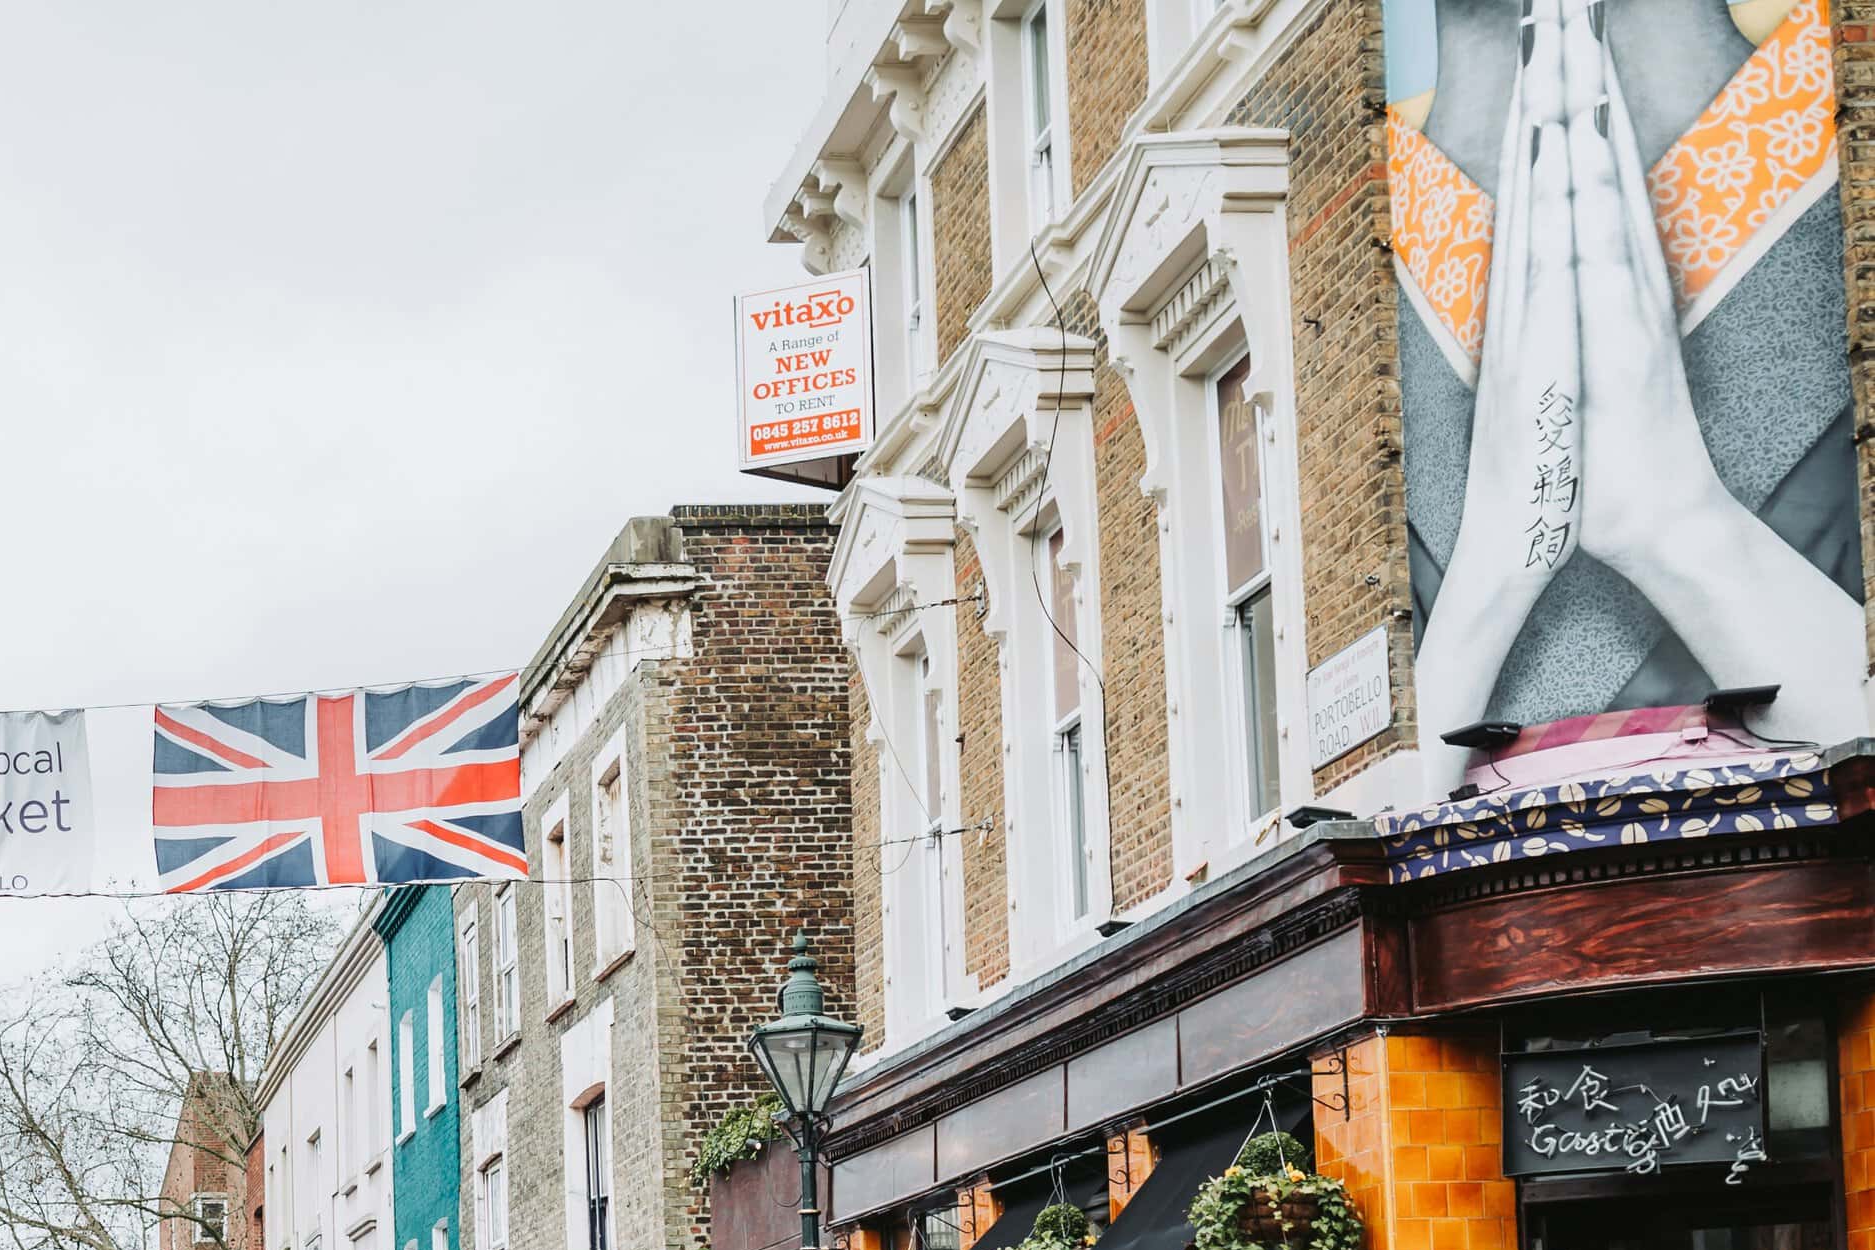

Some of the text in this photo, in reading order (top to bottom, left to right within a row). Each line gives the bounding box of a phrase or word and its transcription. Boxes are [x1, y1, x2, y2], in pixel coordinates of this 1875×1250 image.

[750, 296, 855, 331] vitaxo
[769, 329, 839, 352] A Range of
[775, 349, 832, 374] NEW
[753, 368, 856, 400] OFFICES
[775, 394, 836, 415] TO RENT
[753, 412, 858, 441] 0845 257 8612
[1315, 675, 1382, 734] PORTOBELLO
